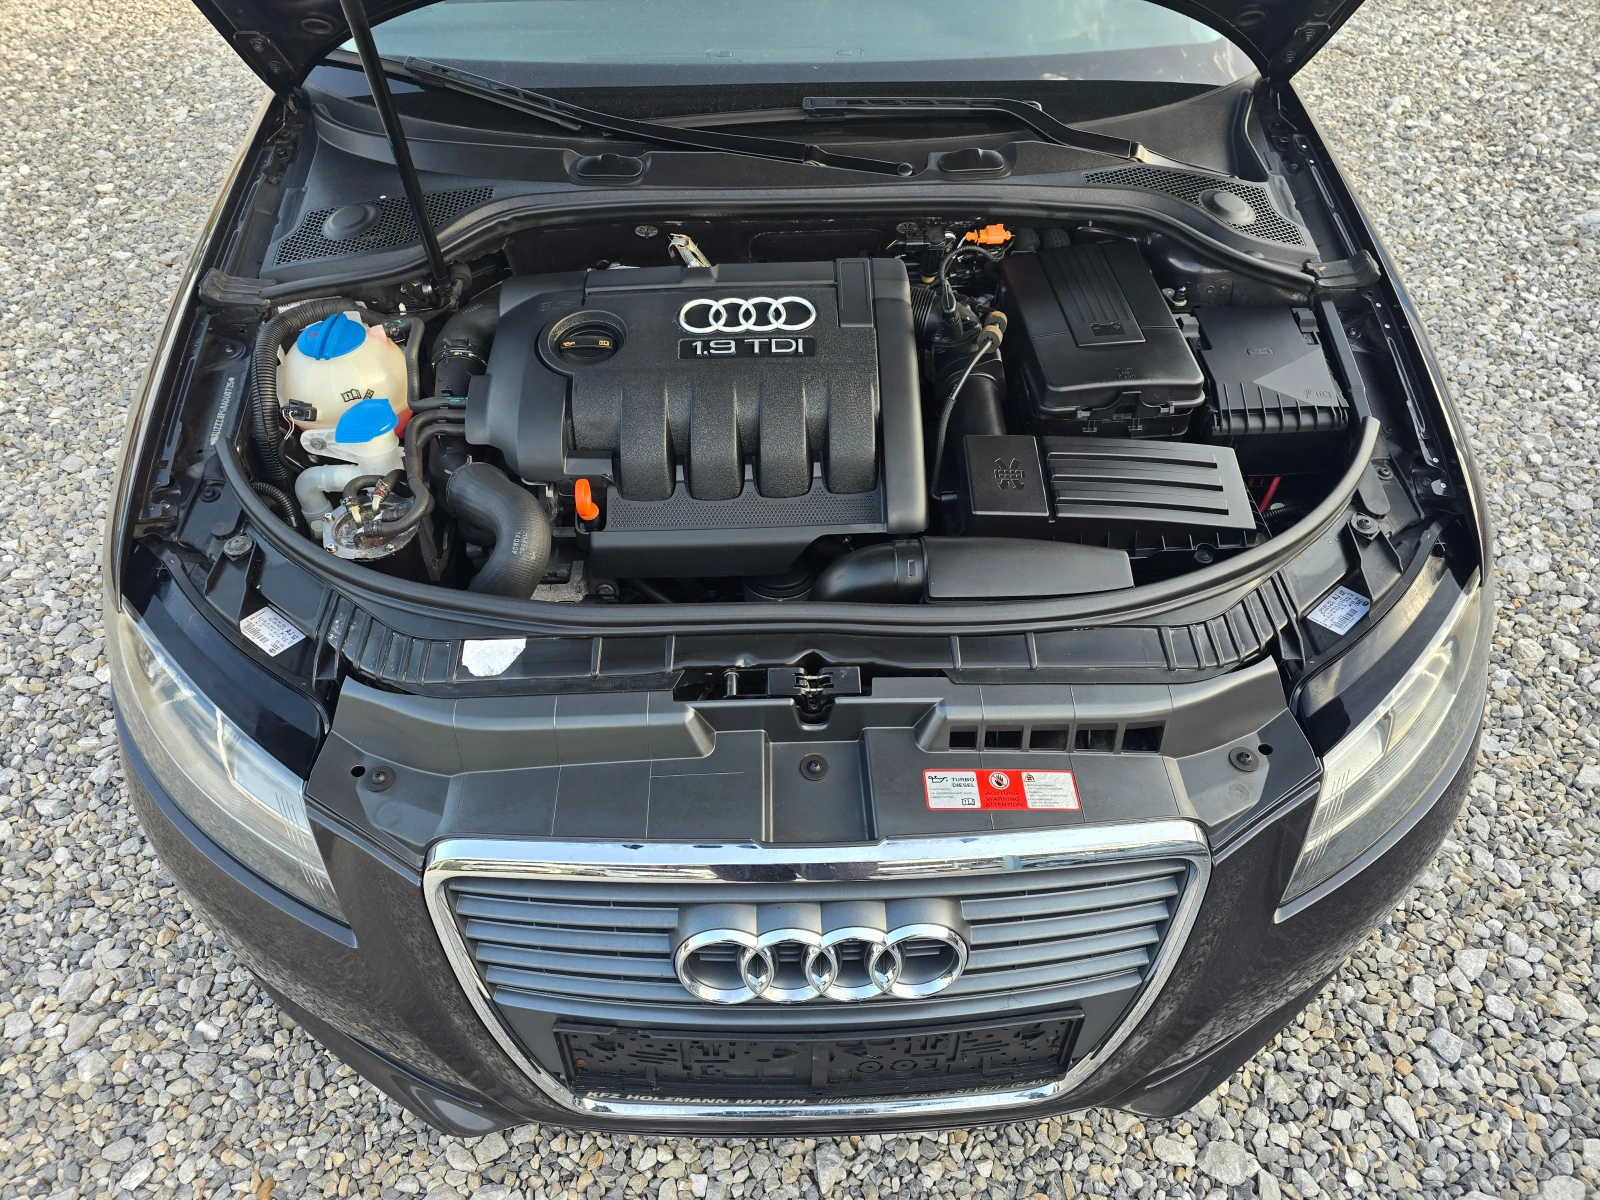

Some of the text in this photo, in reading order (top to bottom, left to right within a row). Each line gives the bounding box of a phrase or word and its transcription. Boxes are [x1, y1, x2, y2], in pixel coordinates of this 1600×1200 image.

[692, 338, 805, 356] 1.9 TDI
[586, 1091, 622, 1099] KFZ
[1011, 1079, 1047, 1088] GLAN
